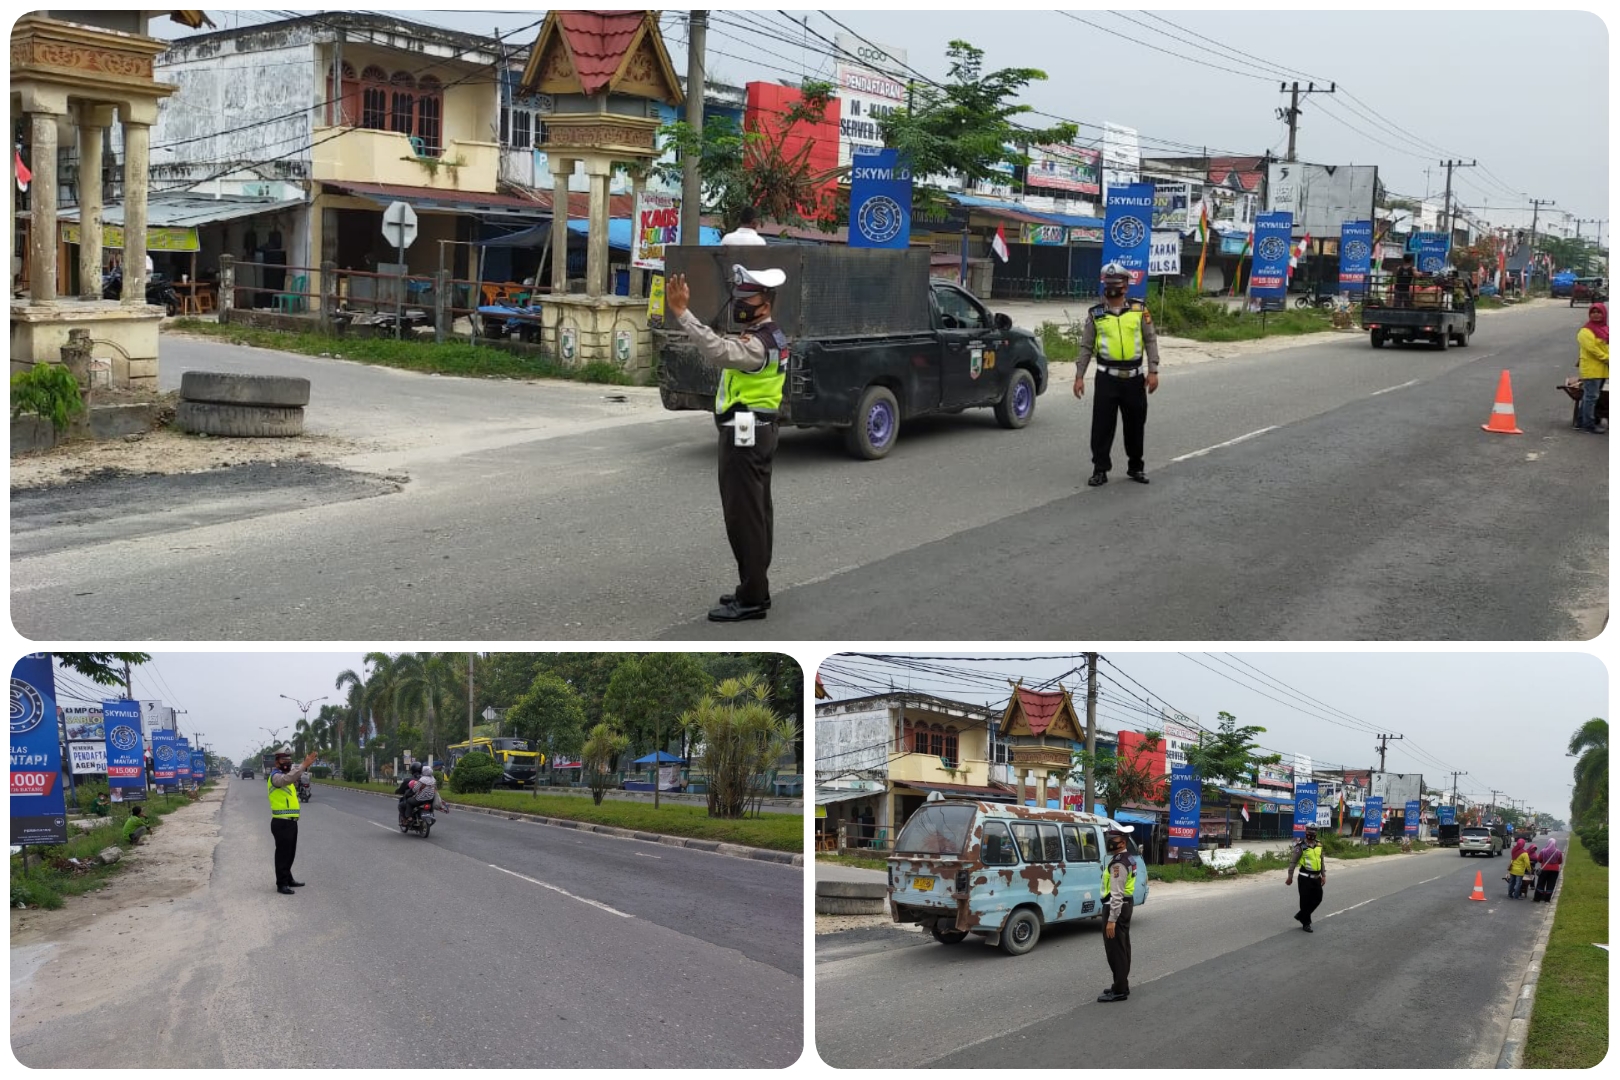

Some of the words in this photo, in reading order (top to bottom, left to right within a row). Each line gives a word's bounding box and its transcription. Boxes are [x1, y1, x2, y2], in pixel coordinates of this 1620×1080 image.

[857, 47, 887, 62] oppo
[841, 118, 874, 140] SERVER
[1108, 196, 1152, 206] SKYMILD
[640, 208, 679, 228] KAOS
[1257, 221, 1291, 229] SKYMILD
[983, 350, 996, 369] 20
[104, 709, 139, 718] SKYMILD
[96, 763, 107, 771] PU
